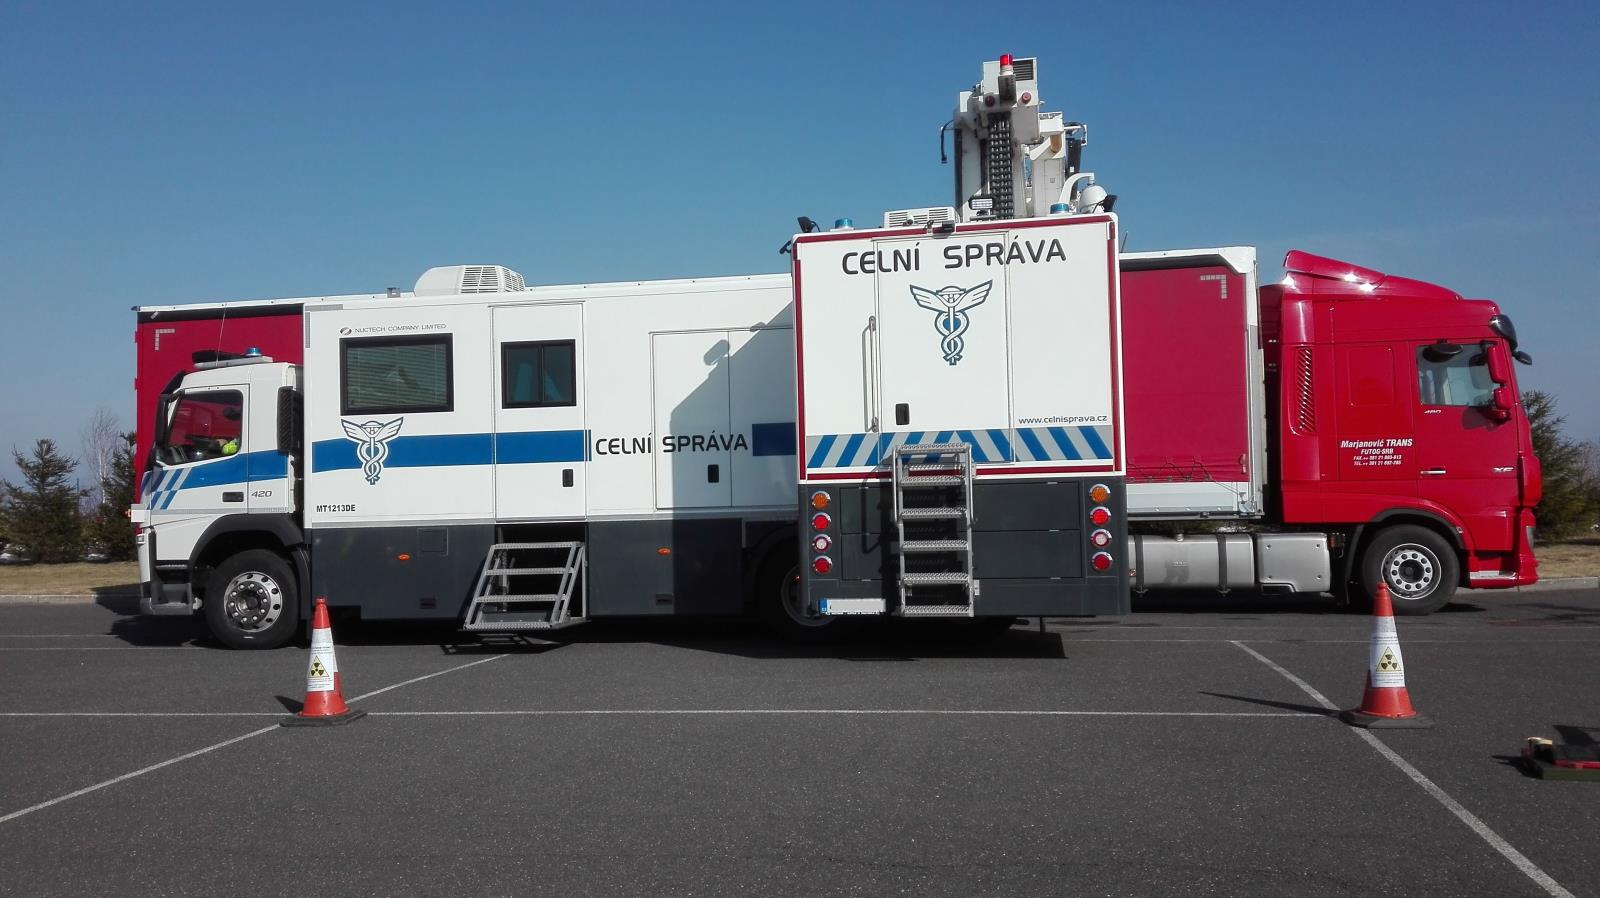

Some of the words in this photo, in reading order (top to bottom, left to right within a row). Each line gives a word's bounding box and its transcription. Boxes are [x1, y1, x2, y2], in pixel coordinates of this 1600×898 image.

[842, 242, 921, 275] CELNÍ
[943, 235, 1067, 269] SPRÁVA
[1018, 415, 1108, 424] www.celnisprava.cz
[595, 432, 652, 455] CELNÍ
[662, 430, 748, 453] SPRÁVA
[1340, 439, 1385, 450] Marjanović
[1386, 438, 1413, 447] TRANS
[251, 490, 273, 498] 420
[316, 504, 356, 513] MT1213DE
